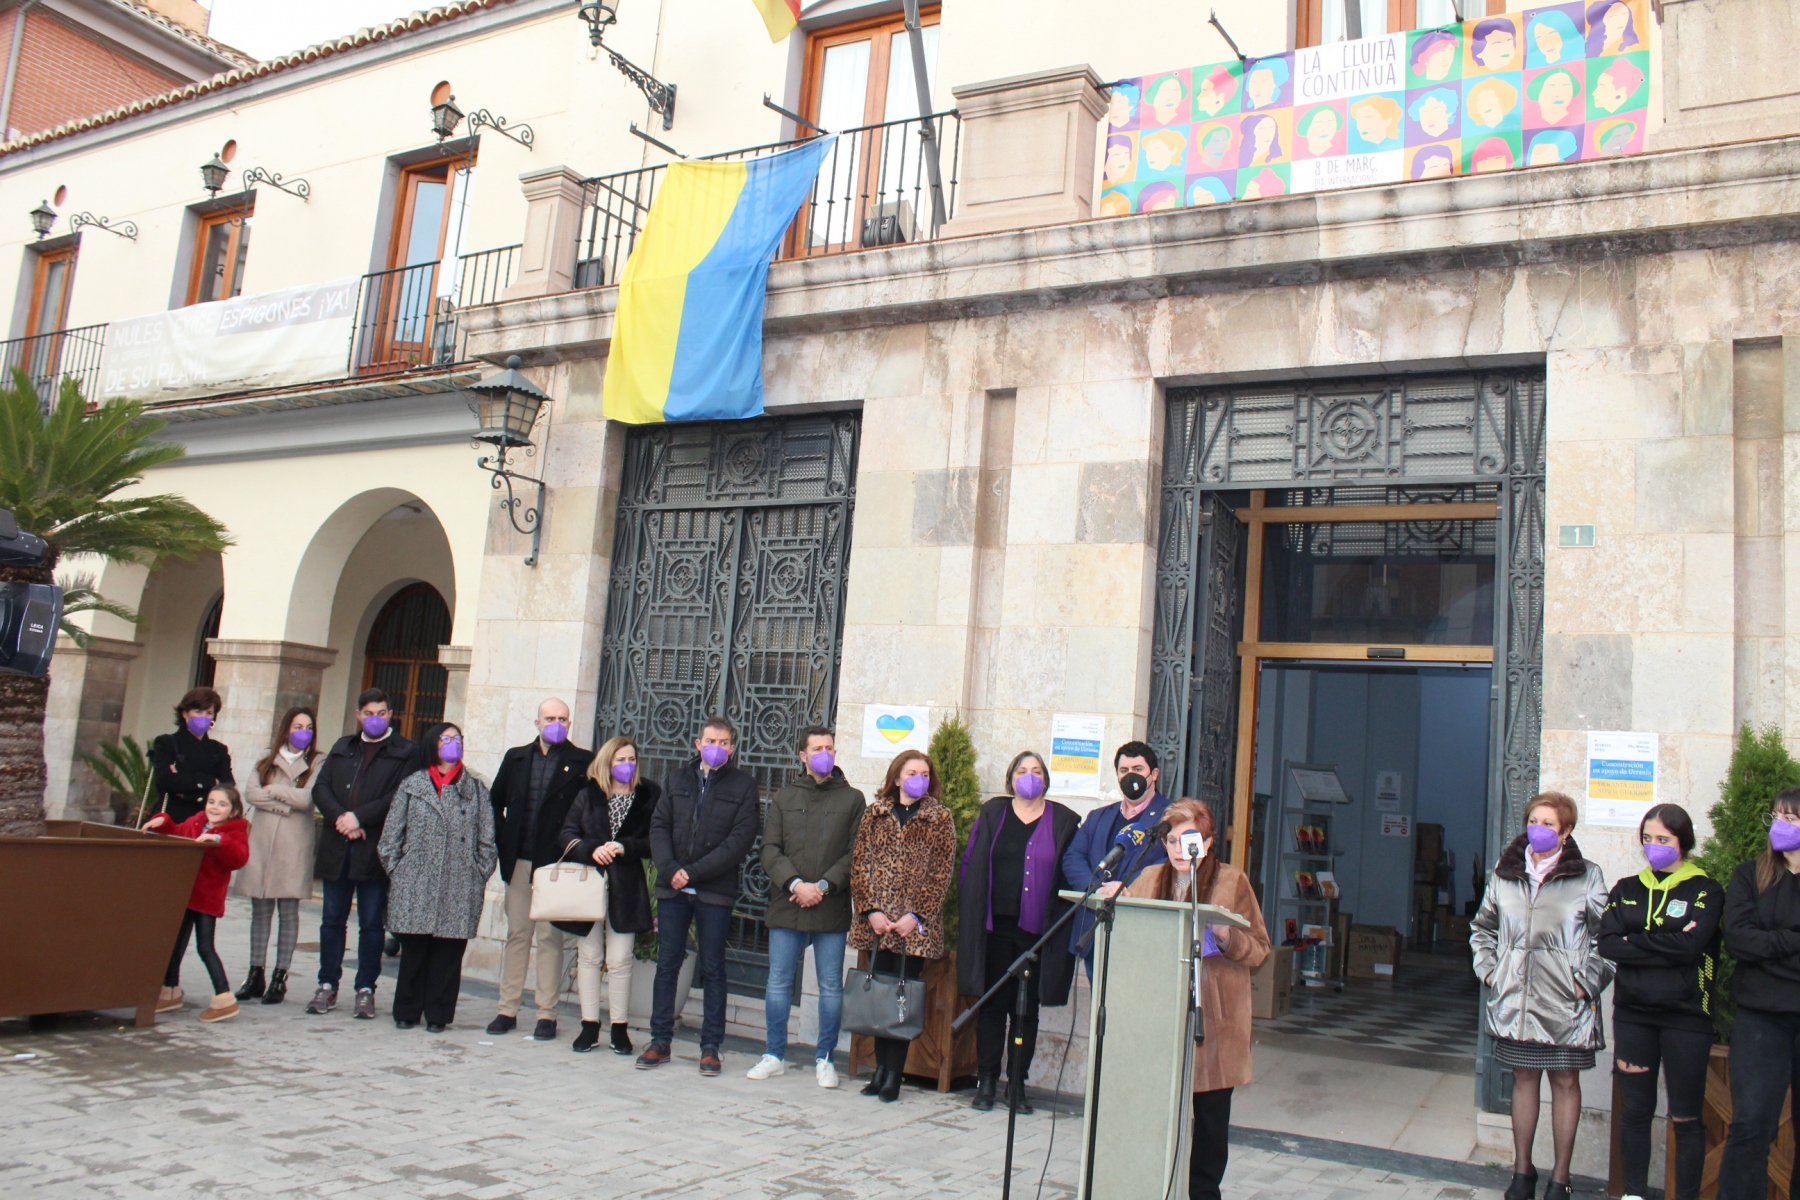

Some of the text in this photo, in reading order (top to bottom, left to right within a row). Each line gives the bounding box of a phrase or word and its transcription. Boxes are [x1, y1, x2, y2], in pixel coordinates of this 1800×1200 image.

[1303, 38, 1396, 75] LA LLUITA
[1302, 62, 1396, 98] CONTINUA
[1314, 161, 1321, 176] 8
[1327, 159, 1340, 175] DE
[1314, 173, 1378, 187] DIA INTERNACIONAL
[113, 321, 163, 349] NULES
[172, 311, 218, 339] EXIGE
[220, 296, 311, 330] ESPIGONES
[318, 288, 351, 319] ¡YA!
[104, 358, 207, 393] DE SU PLAYA
[1573, 526, 1581, 545] 1
[1132, 829, 1146, 846] 4
